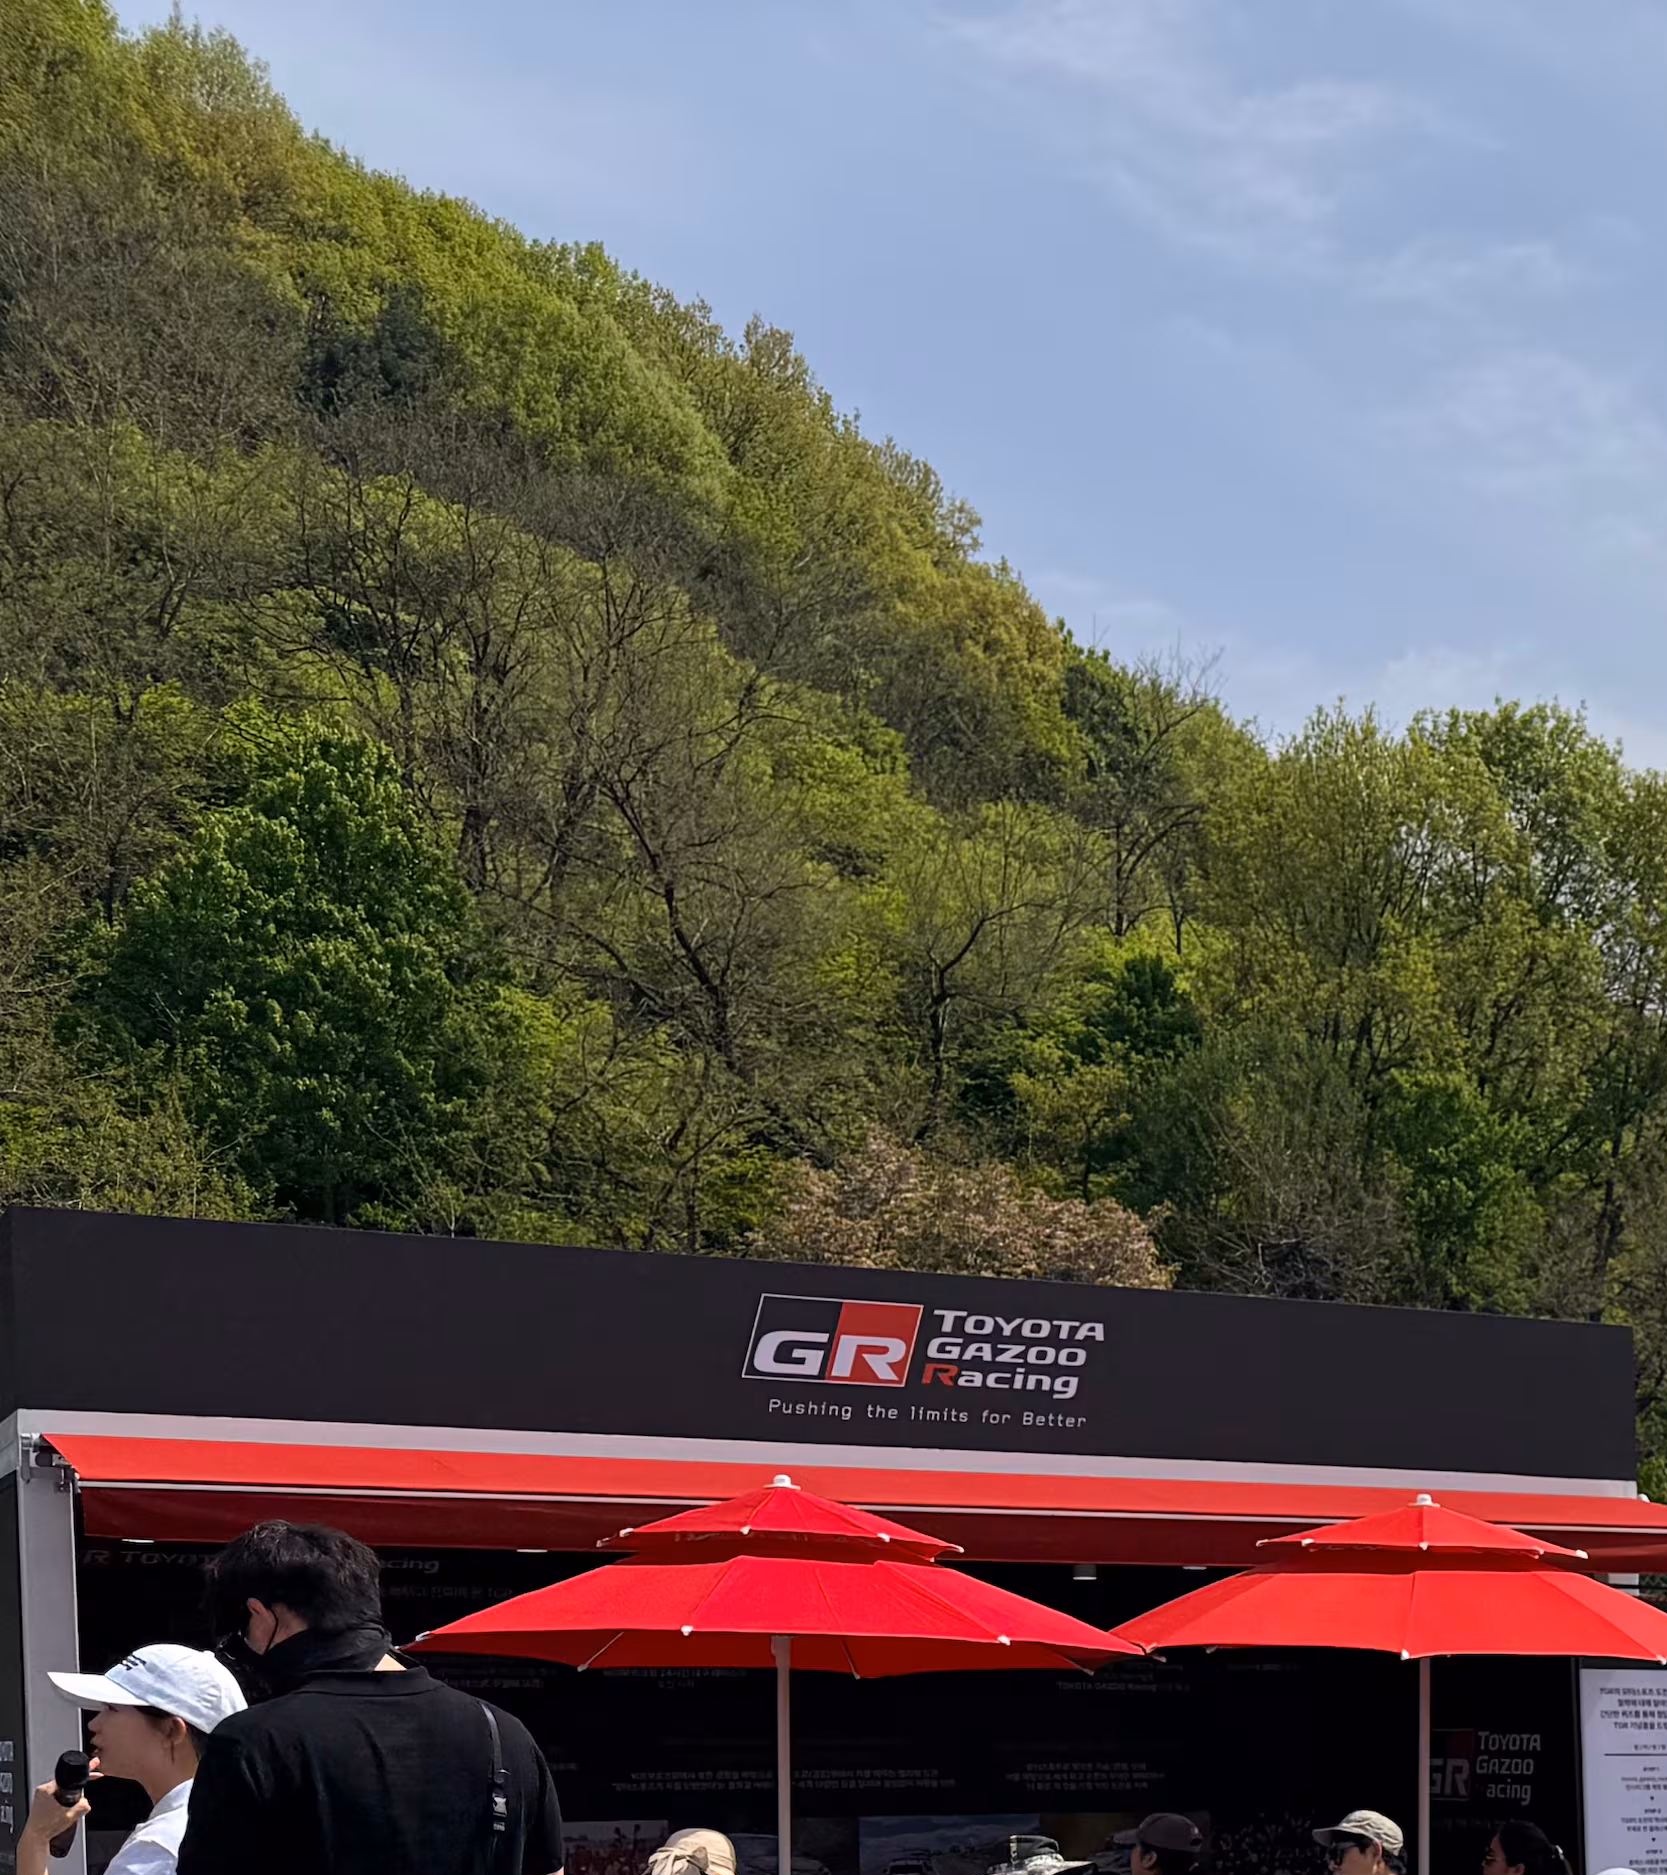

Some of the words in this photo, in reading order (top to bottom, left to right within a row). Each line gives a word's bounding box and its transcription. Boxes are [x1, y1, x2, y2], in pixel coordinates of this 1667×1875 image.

[933, 1309, 1105, 1342] TOYOTA
[752, 1330, 908, 1382] GR
[926, 1338, 1087, 1367] GAZOO
[921, 1363, 1079, 1399] Racing
[768, 1399, 853, 1420] Pushing
[867, 1404, 898, 1420] the
[910, 1406, 969, 1423] limits
[981, 1408, 1011, 1426] for
[1022, 1411, 1087, 1429] Better
[1477, 1730, 1542, 1752] TOYOTA
[1475, 1755, 1535, 1775] GAZOO
